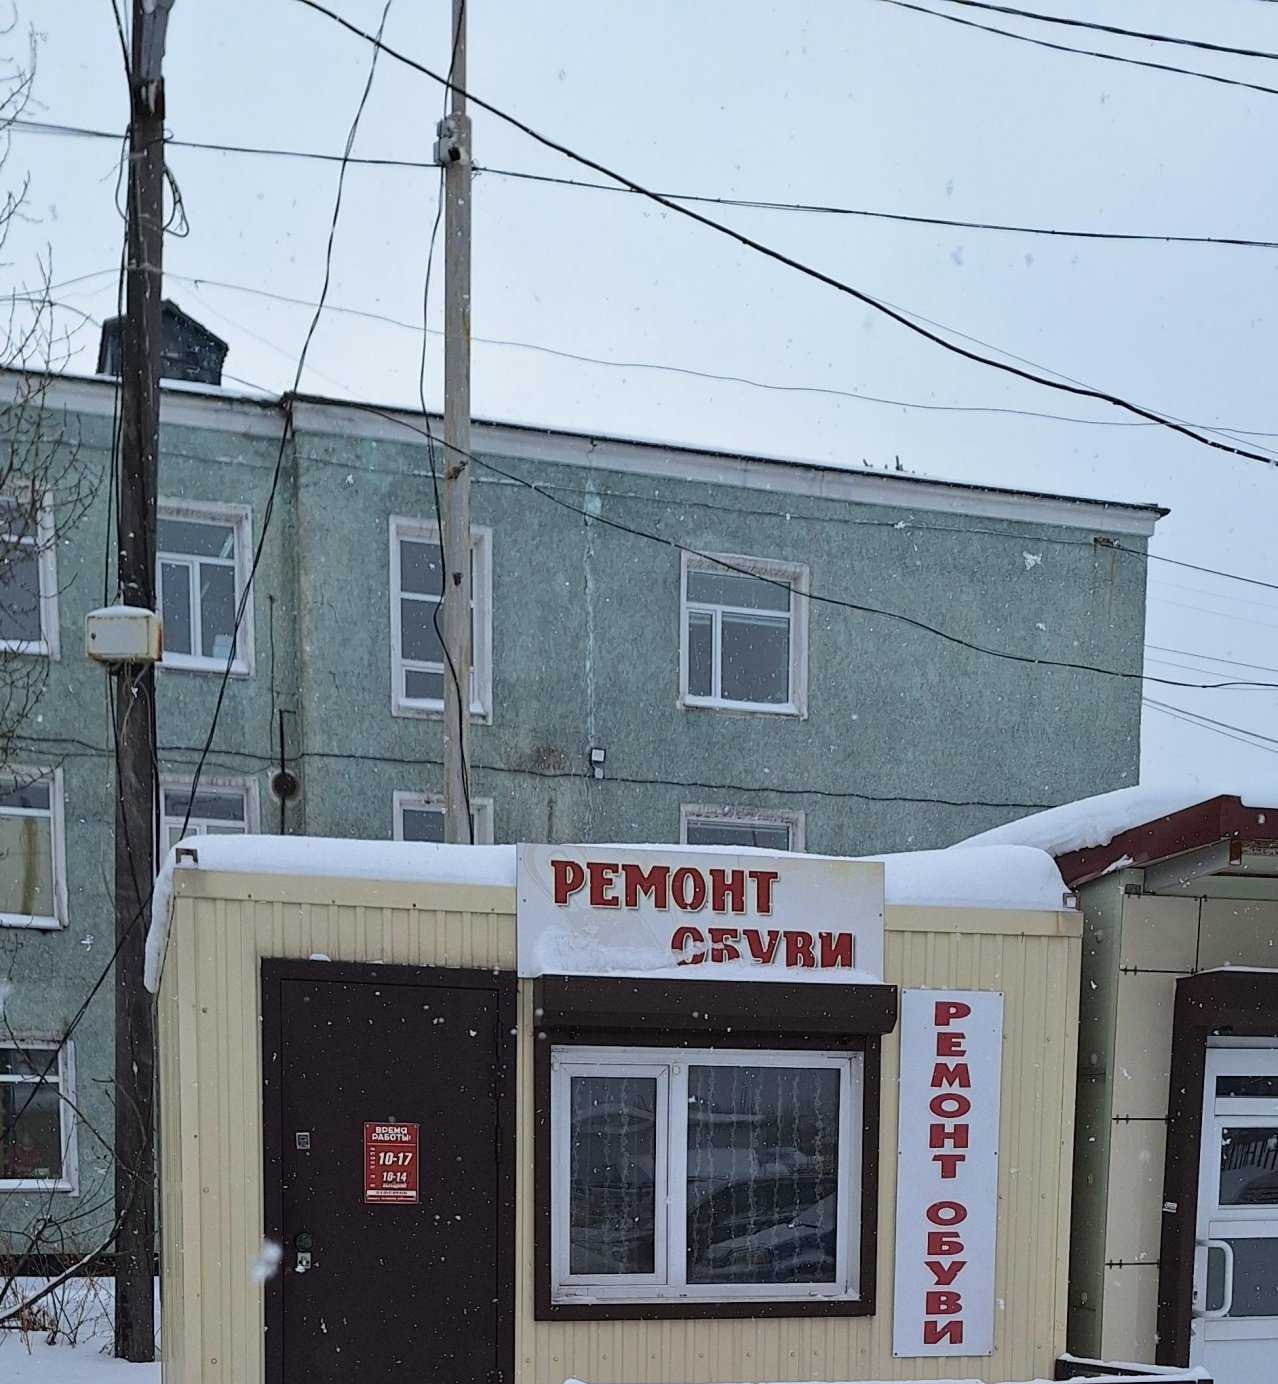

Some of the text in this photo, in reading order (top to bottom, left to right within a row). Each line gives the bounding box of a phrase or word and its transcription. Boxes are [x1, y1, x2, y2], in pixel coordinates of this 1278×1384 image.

[551, 860, 780, 914] РЕМОНТ
[671, 926, 857, 968] ОБУВИ
[375, 1126, 408, 1134] ВРЕМЯ
[378, 1152, 413, 1166] 10-17
[923, 1000, 972, 1345] РЕМОНТ ОБУВИ
[382, 1171, 407, 1182] 10-14
